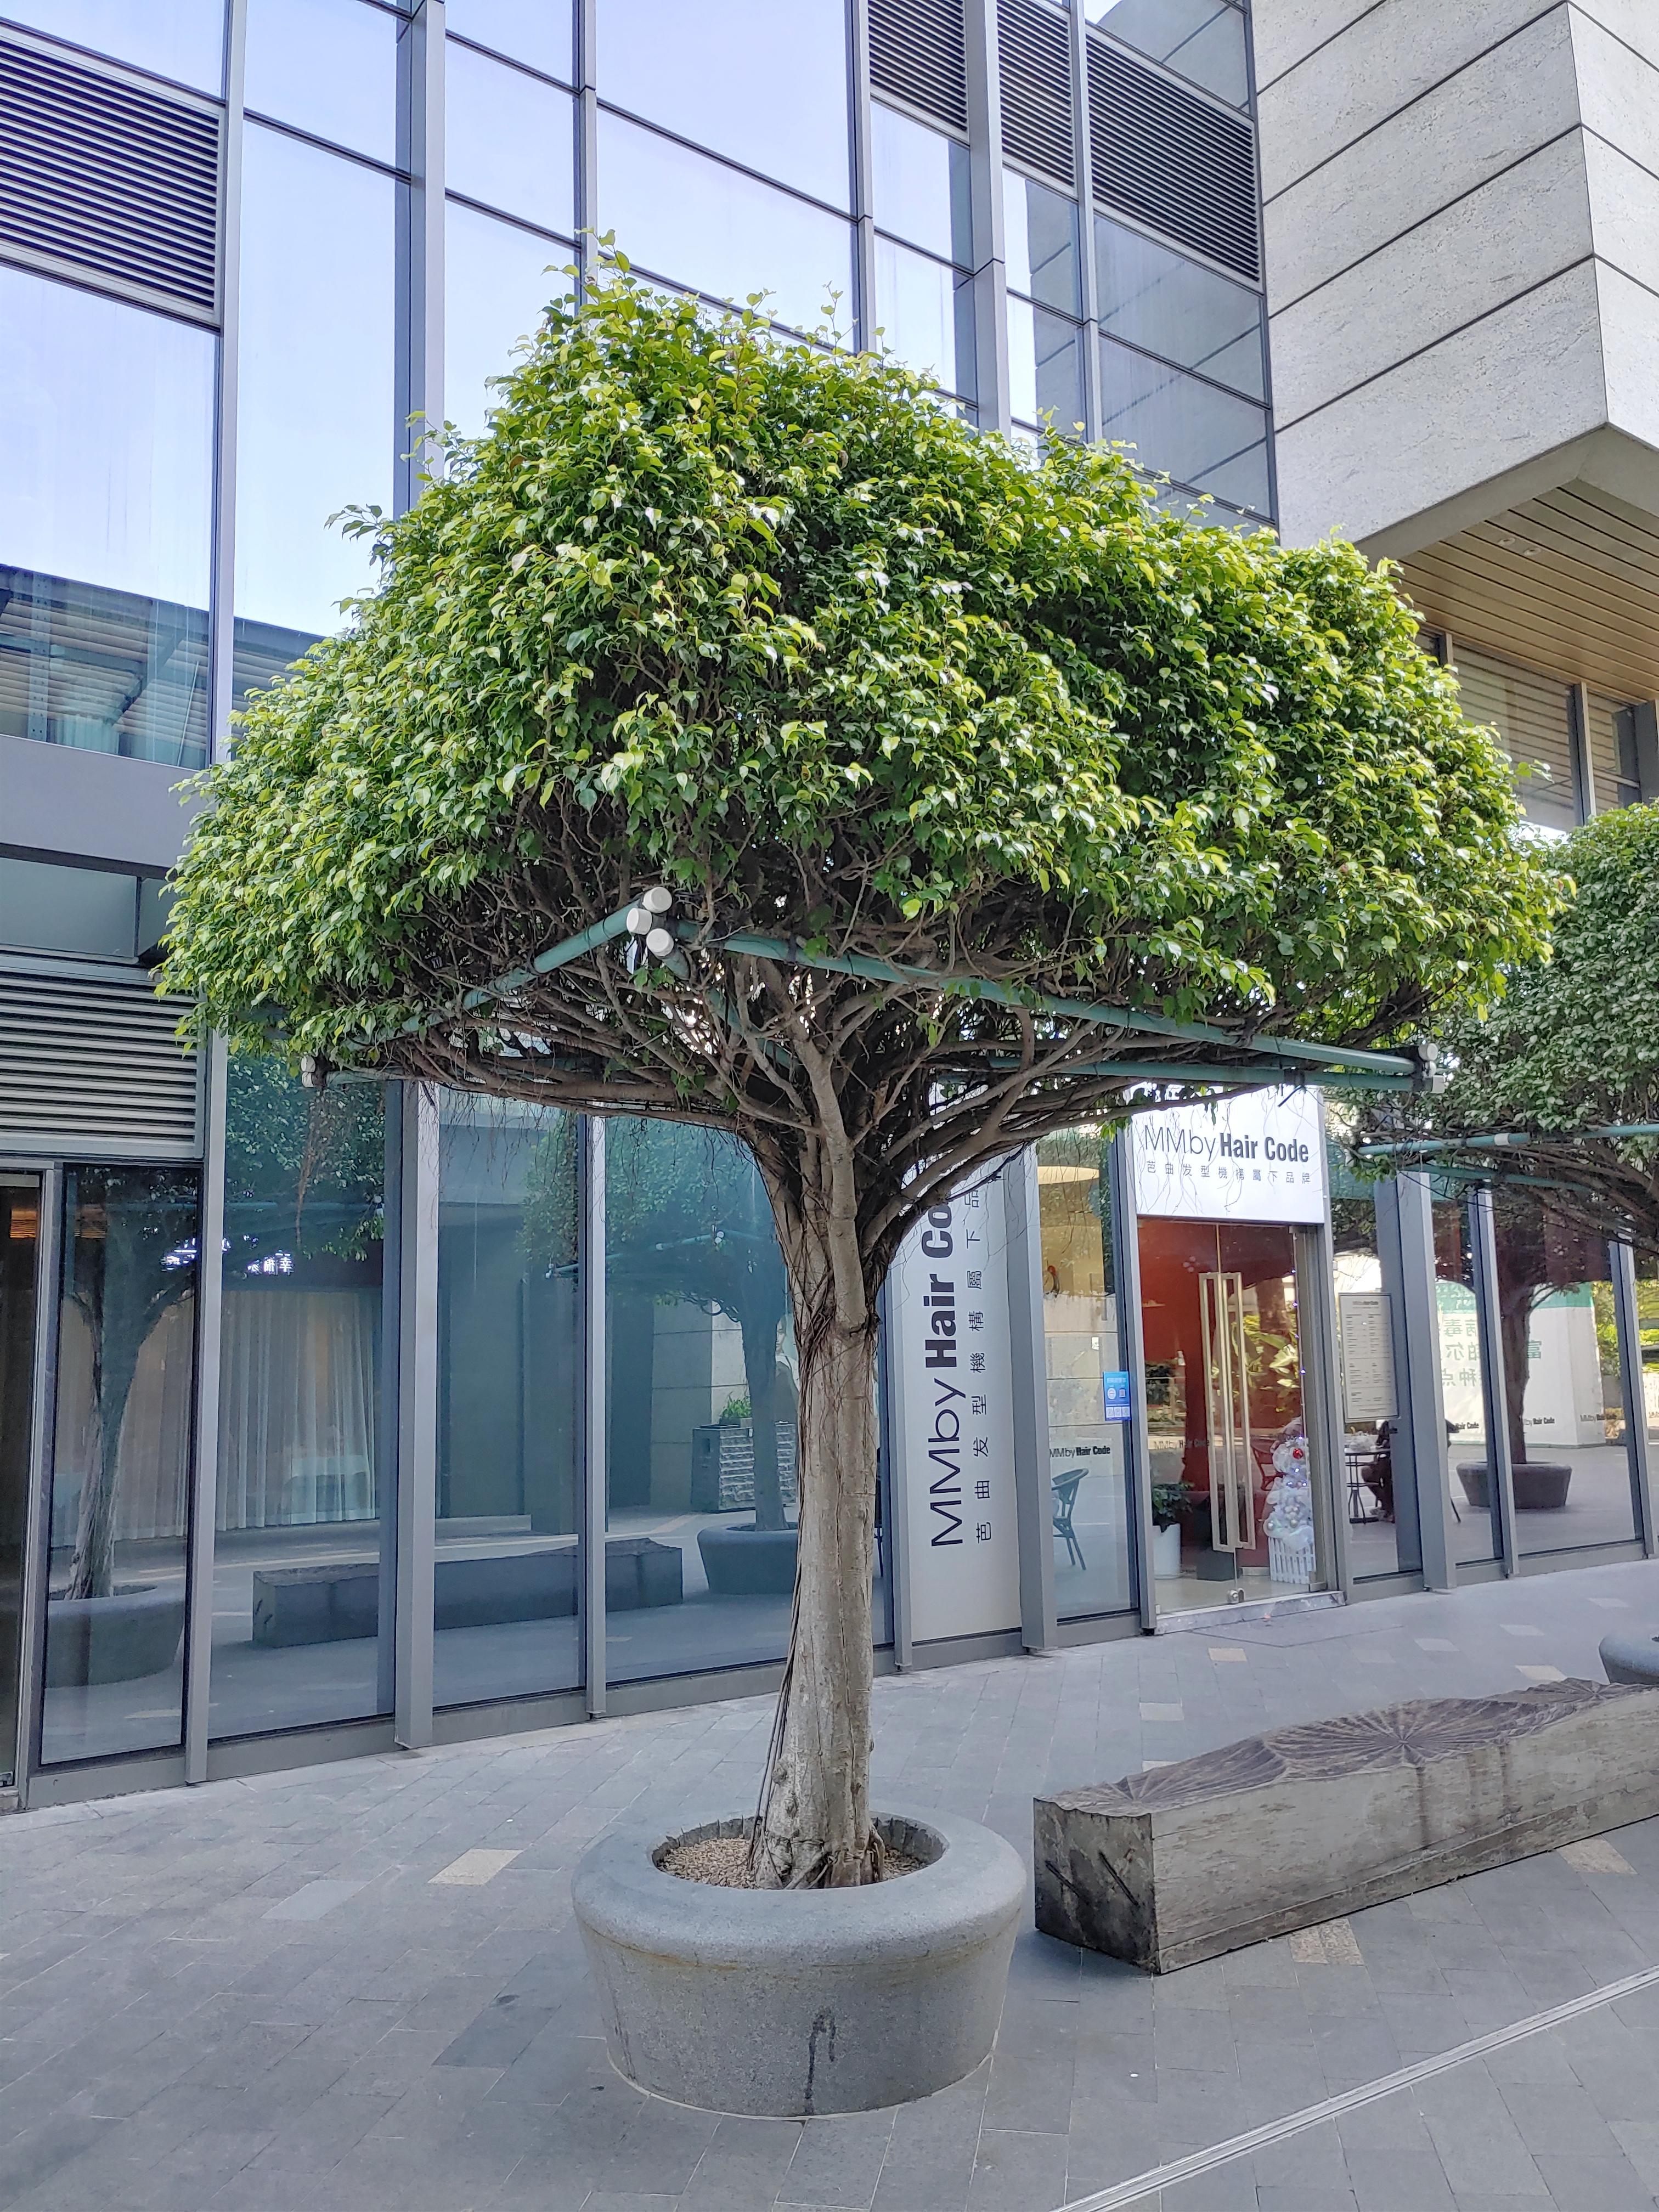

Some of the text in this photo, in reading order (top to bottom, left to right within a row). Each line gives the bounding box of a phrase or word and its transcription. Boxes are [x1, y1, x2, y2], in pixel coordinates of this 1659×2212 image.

[1144, 1125, 1309, 1163] MMby Hair Code
[923, 1273, 957, 1368] Hair
[928, 1378, 966, 1547] MMby
[1075, 1447, 1092, 1456] Hair
[1092, 1446, 1111, 1455] Code
